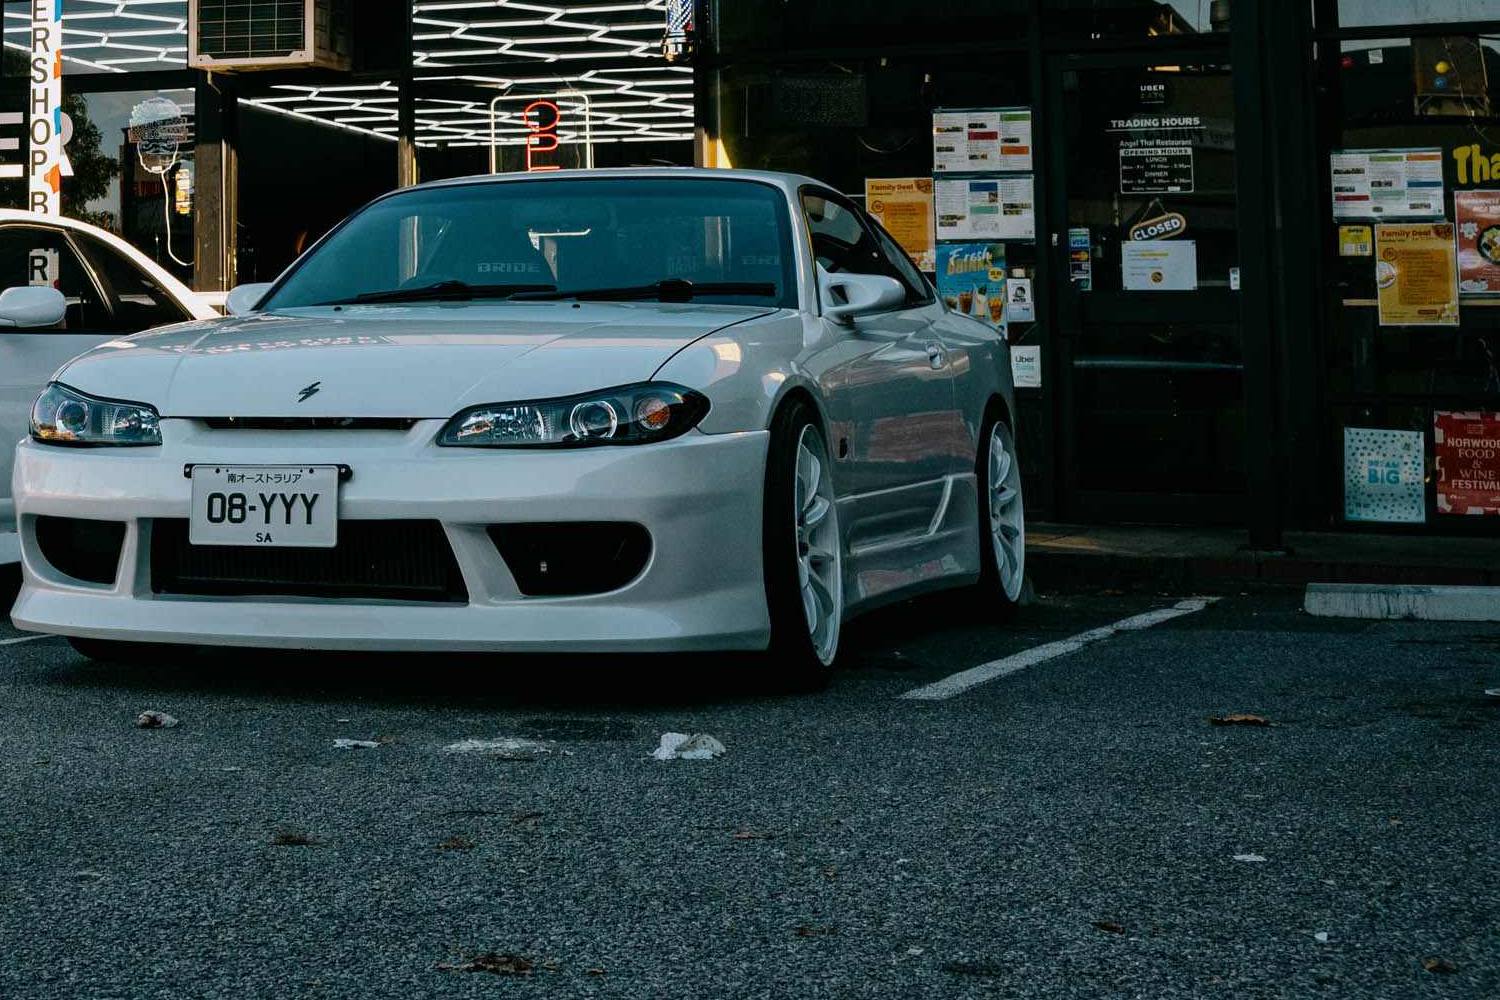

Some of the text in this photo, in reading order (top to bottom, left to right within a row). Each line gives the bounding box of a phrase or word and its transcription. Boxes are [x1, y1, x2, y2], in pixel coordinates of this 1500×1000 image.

[1140, 84, 1165, 92] UBER
[1110, 117, 1201, 129] TRADING HOURS
[1120, 139, 1139, 148] Angel
[871, 184, 896, 192] Family
[1134, 218, 1181, 241] CLOSED
[1381, 230, 1411, 238] Family
[949, 246, 990, 265] Fresh
[476, 262, 541, 273] BRIDE
[1015, 355, 1035, 363] Uber
[1458, 448, 1495, 459] FOOD
[227, 473, 302, 484] 南オーストラリア
[1368, 469, 1400, 484] BIG
[1459, 469, 1496, 480] WINE
[207, 492, 320, 525] 08-YYY
[255, 532, 273, 543] SA
